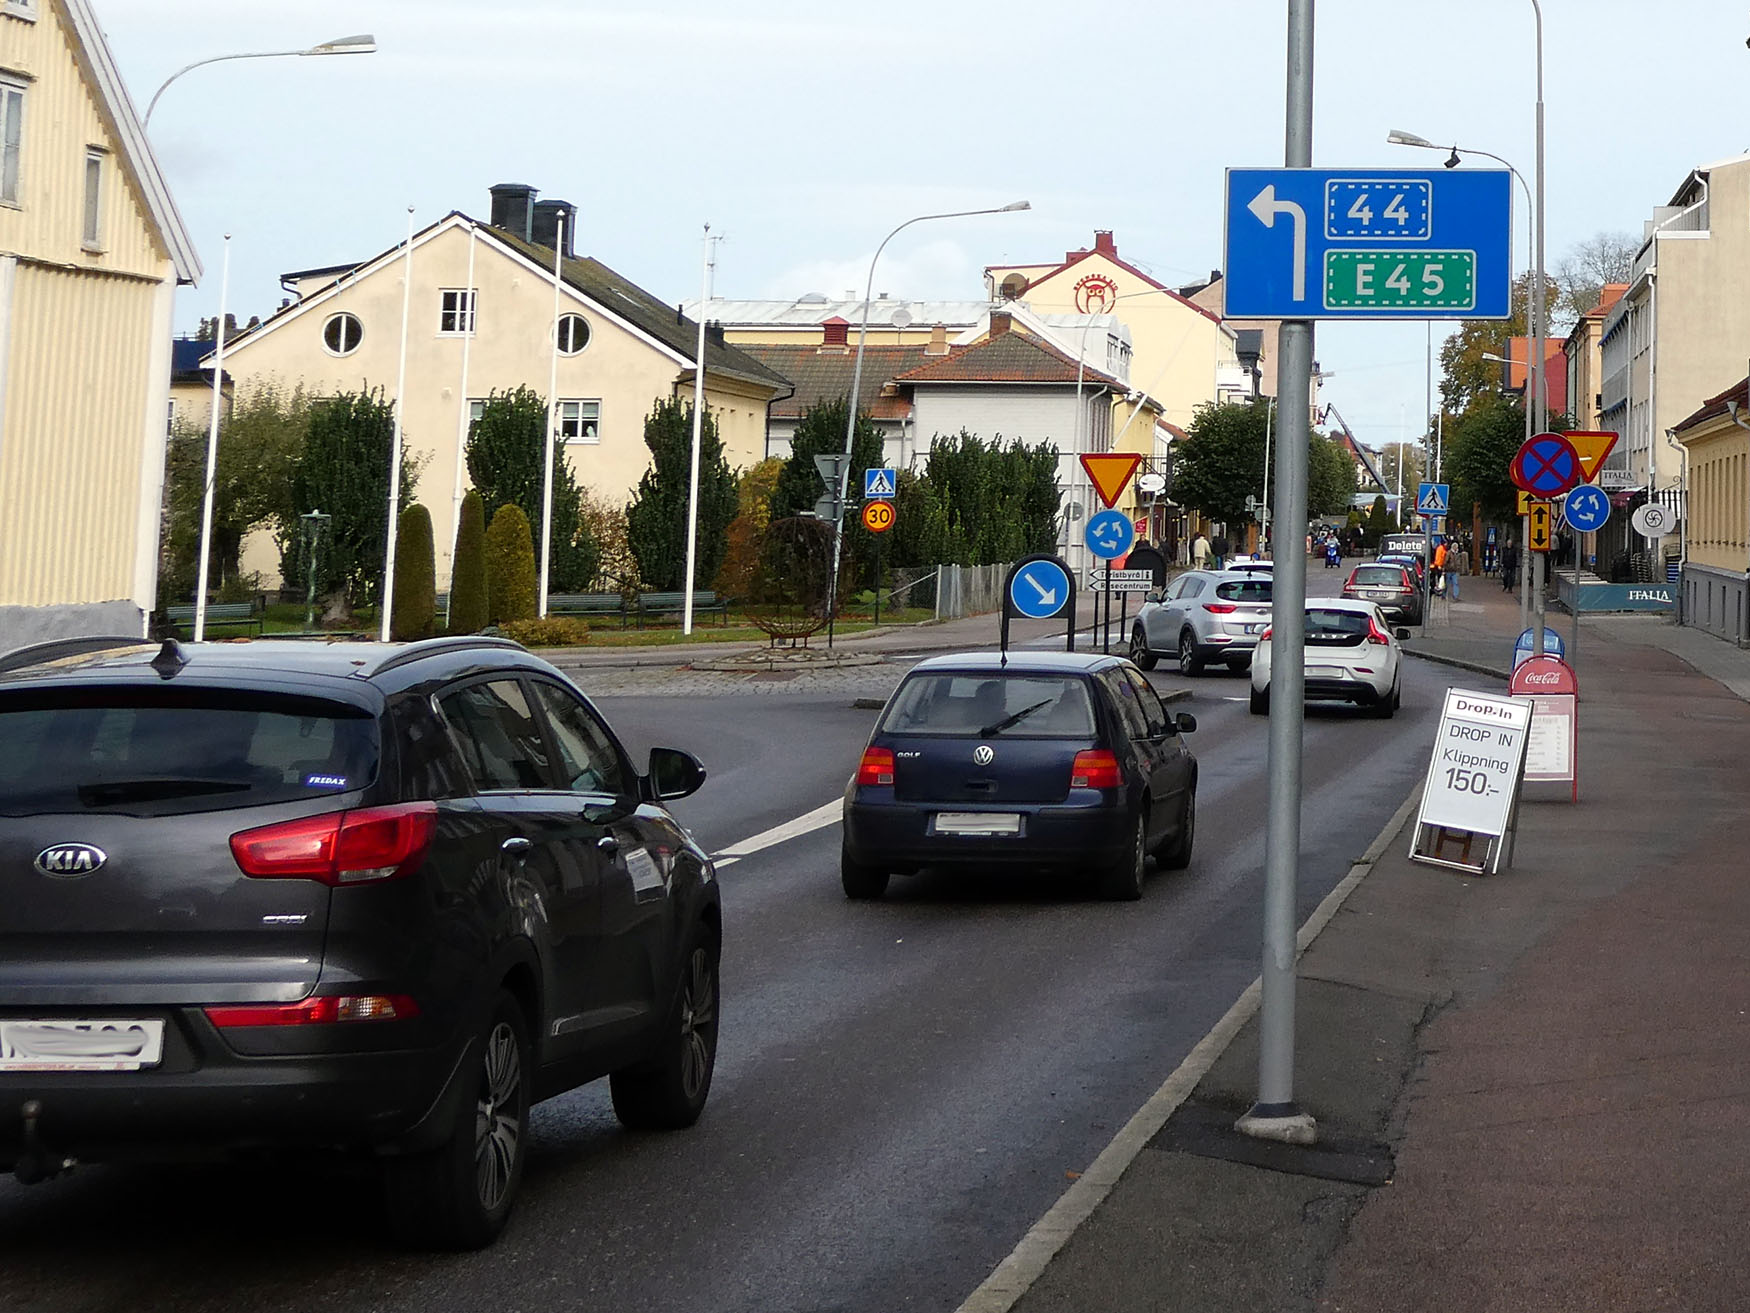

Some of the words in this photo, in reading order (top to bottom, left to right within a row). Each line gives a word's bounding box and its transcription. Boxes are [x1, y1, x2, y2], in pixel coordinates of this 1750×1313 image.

[1347, 193, 1409, 226] 44
[1356, 263, 1444, 296] E45
[1604, 471, 1633, 479] ITALIA
[869, 508, 890, 524] 30
[1388, 541, 1422, 551] Delete
[1629, 590, 1670, 601] ITALIA
[1449, 724, 1491, 742] DROP
[1498, 733, 1513, 747] IN
[1443, 748, 1509, 774] Klippning
[309, 776, 346, 785] FREDAX
[46, 850, 93, 870] KIA
